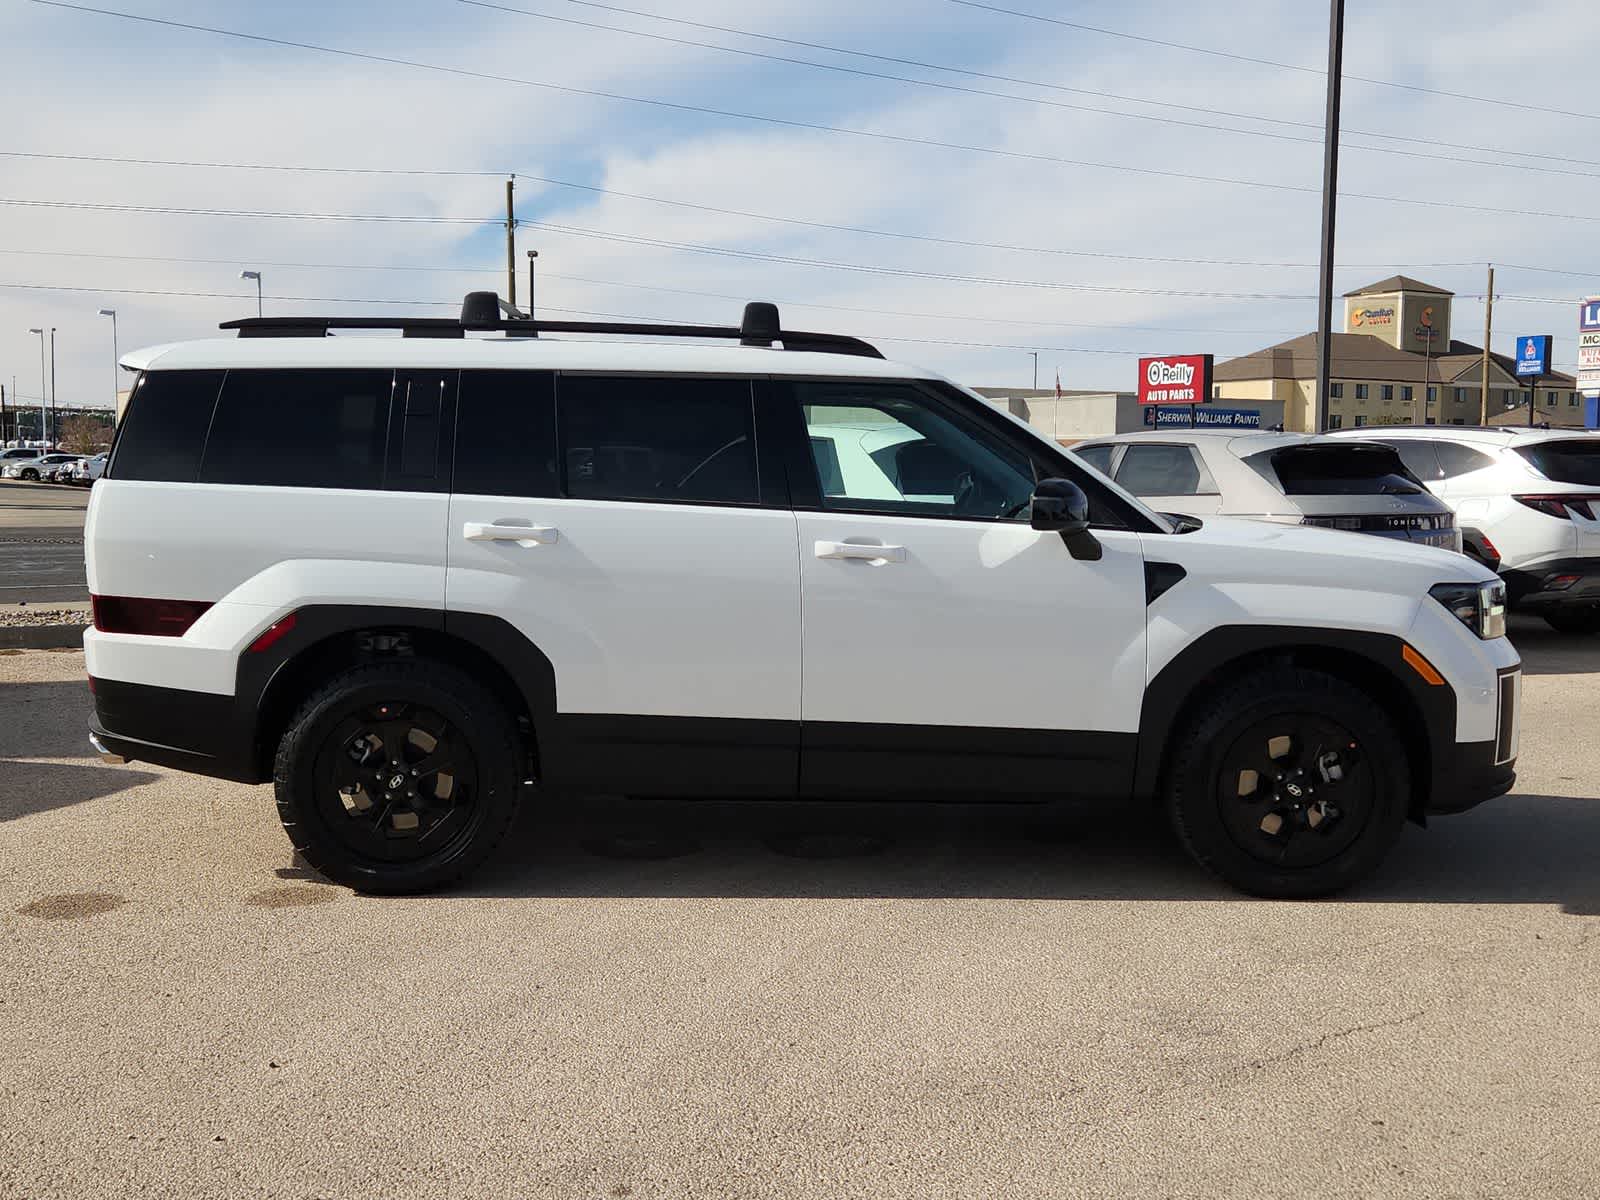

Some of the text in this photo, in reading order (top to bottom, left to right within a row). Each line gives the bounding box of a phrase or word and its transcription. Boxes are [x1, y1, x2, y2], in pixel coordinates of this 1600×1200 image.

[1148, 362, 1194, 385] O'Reilly
[1147, 388, 1194, 401] AUTO PARTS
[1234, 413, 1260, 425] PAINTS
